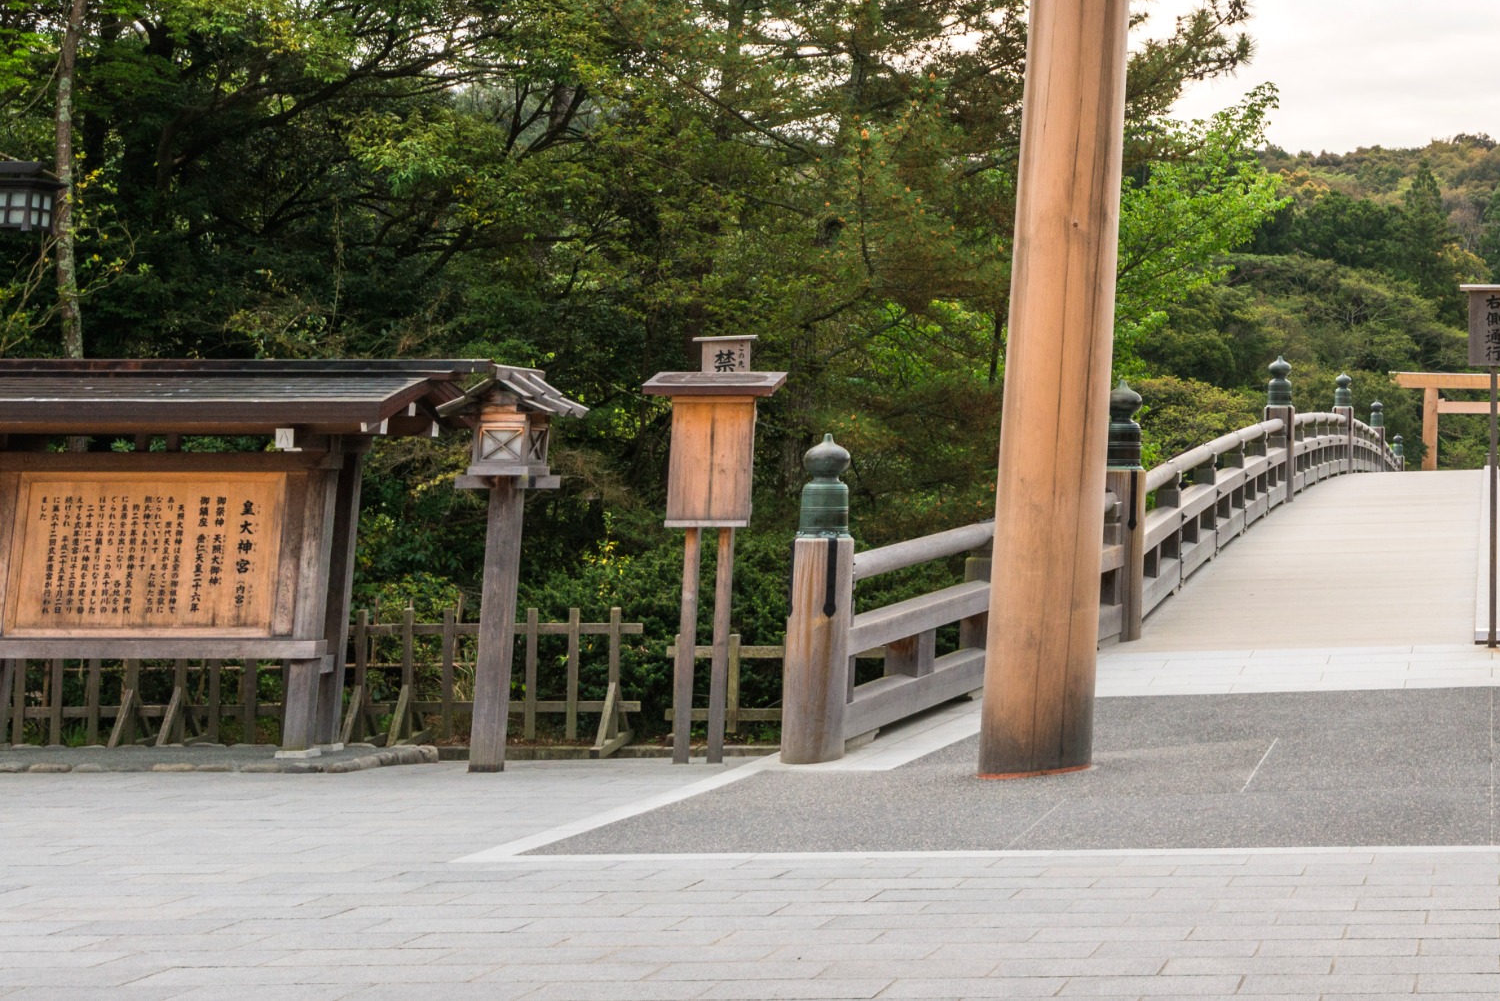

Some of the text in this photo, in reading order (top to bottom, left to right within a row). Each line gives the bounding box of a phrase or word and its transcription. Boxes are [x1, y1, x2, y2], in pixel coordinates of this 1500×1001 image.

[39, 496, 48, 521] ました
[167, 496, 175, 512] あり
[145, 496, 164, 613] なられています また私たちの
[208, 533, 222, 587] 天照大御神
